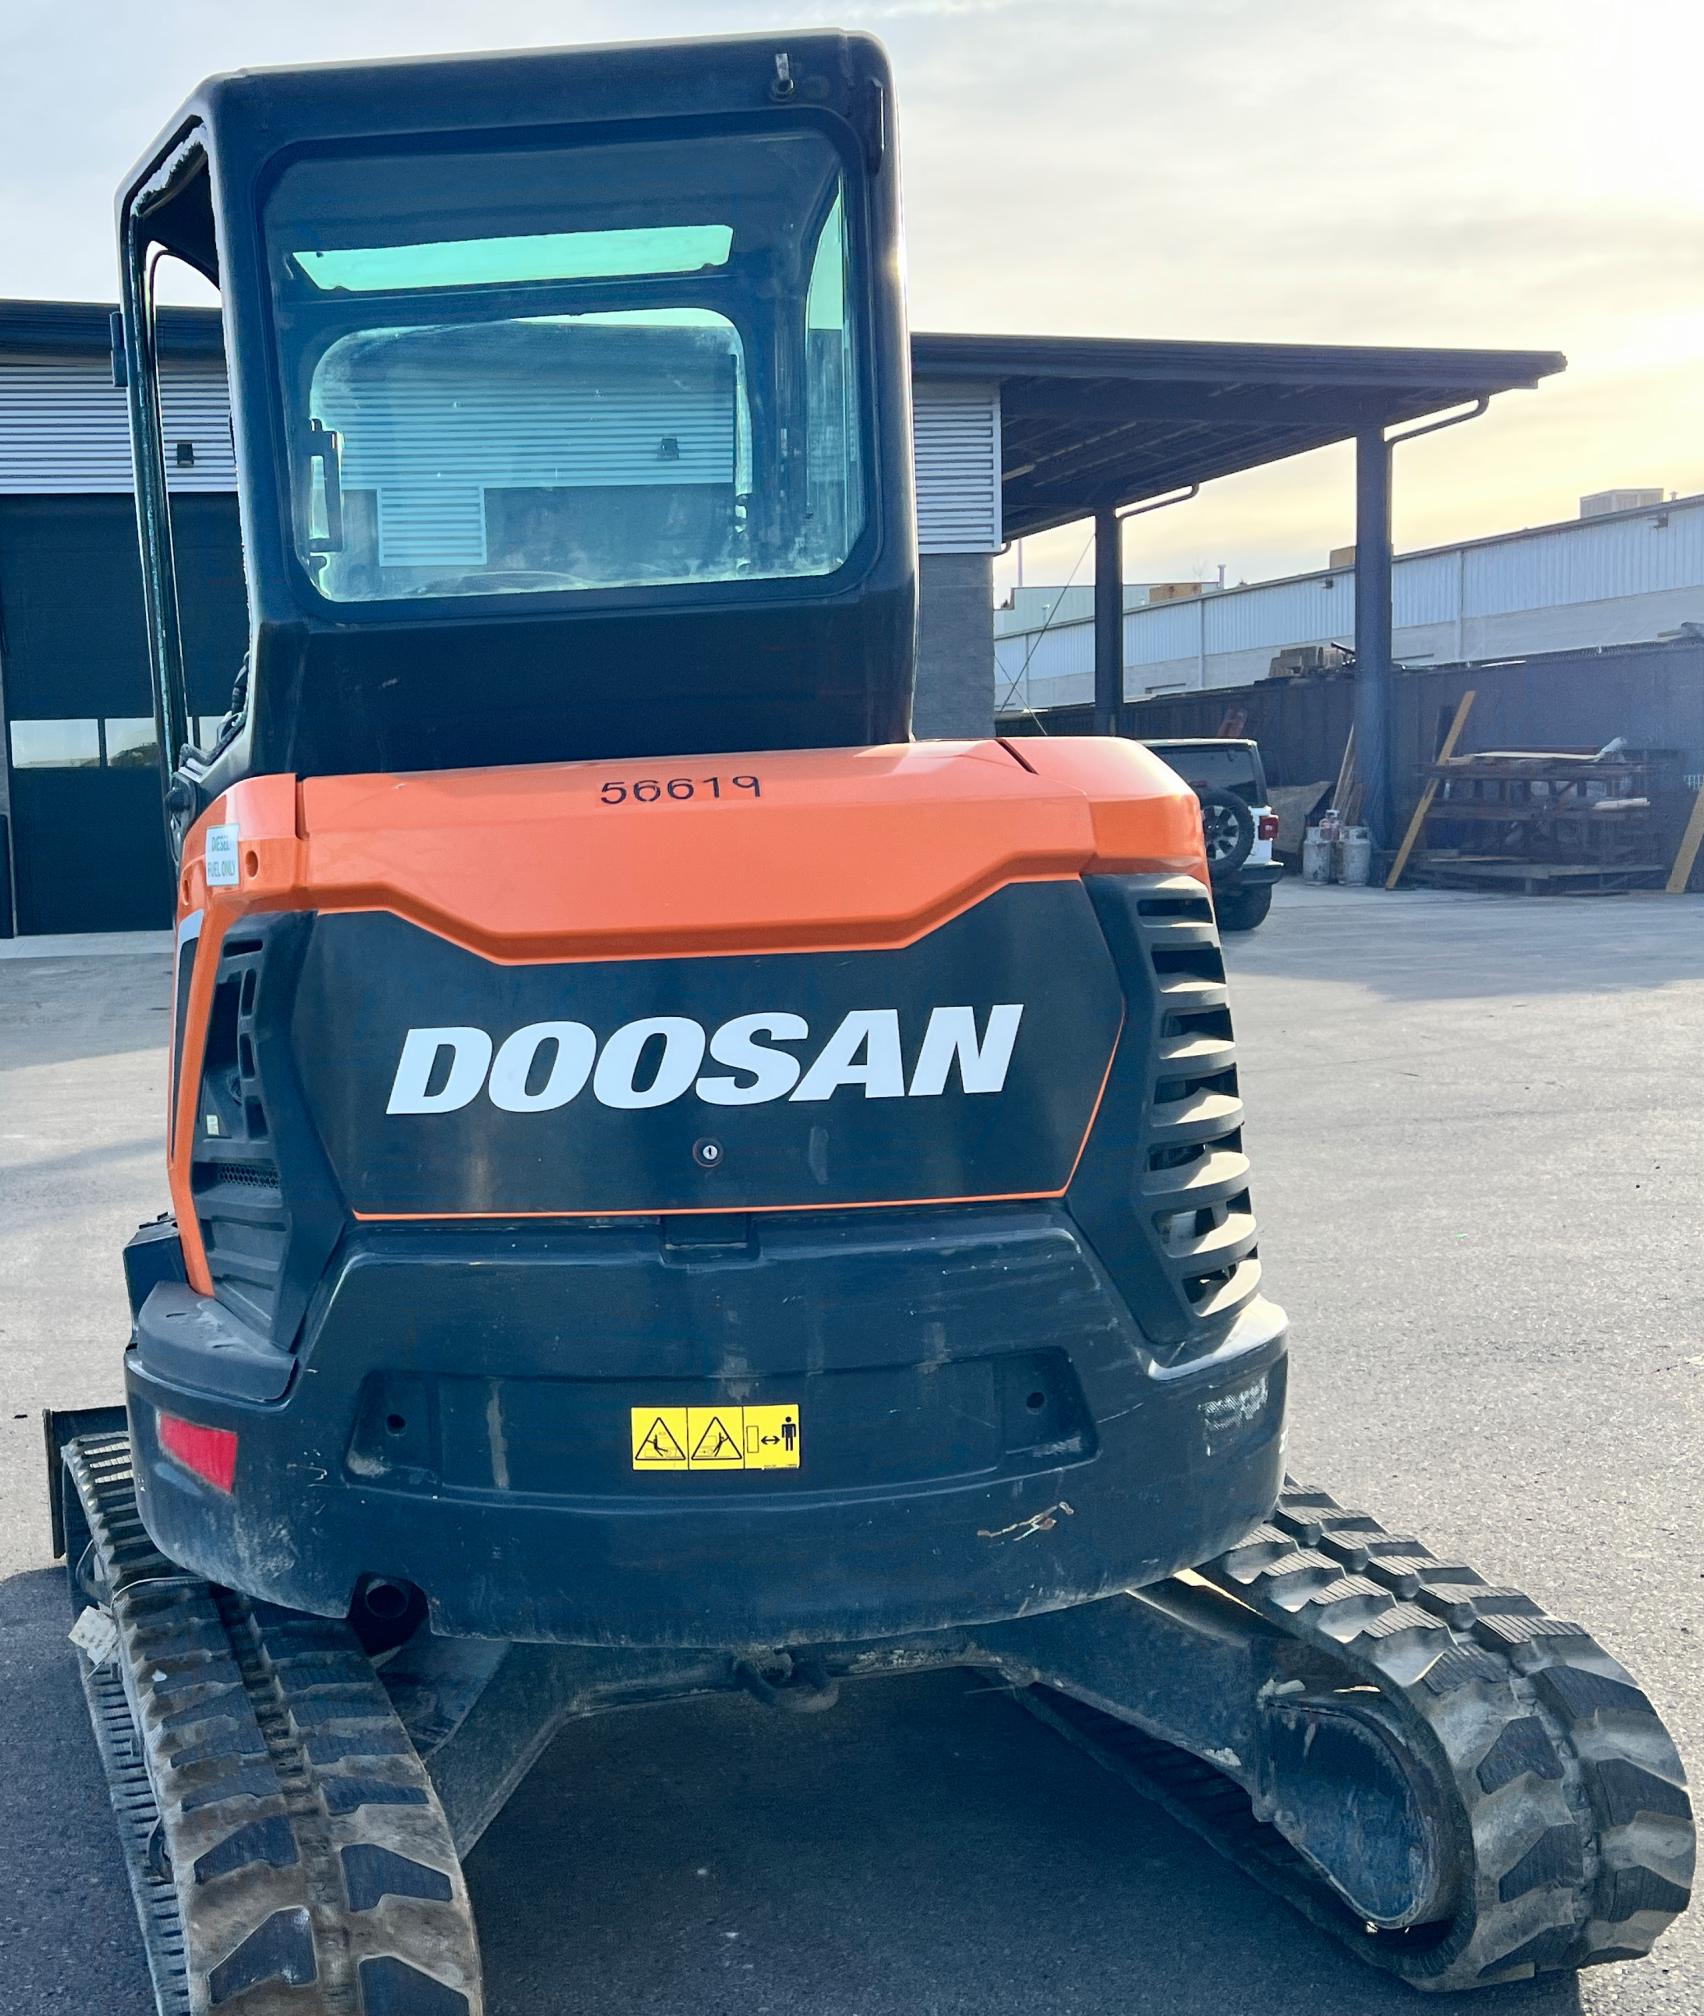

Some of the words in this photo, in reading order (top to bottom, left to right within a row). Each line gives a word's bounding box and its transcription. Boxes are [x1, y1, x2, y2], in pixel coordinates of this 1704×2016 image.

[601, 775, 760, 804] 56619
[211, 835, 230, 852] DIESEL
[208, 861, 221, 877] FUEL
[221, 860, 236, 876] ONLY
[386, 1003, 1024, 1115] DOOSAN
